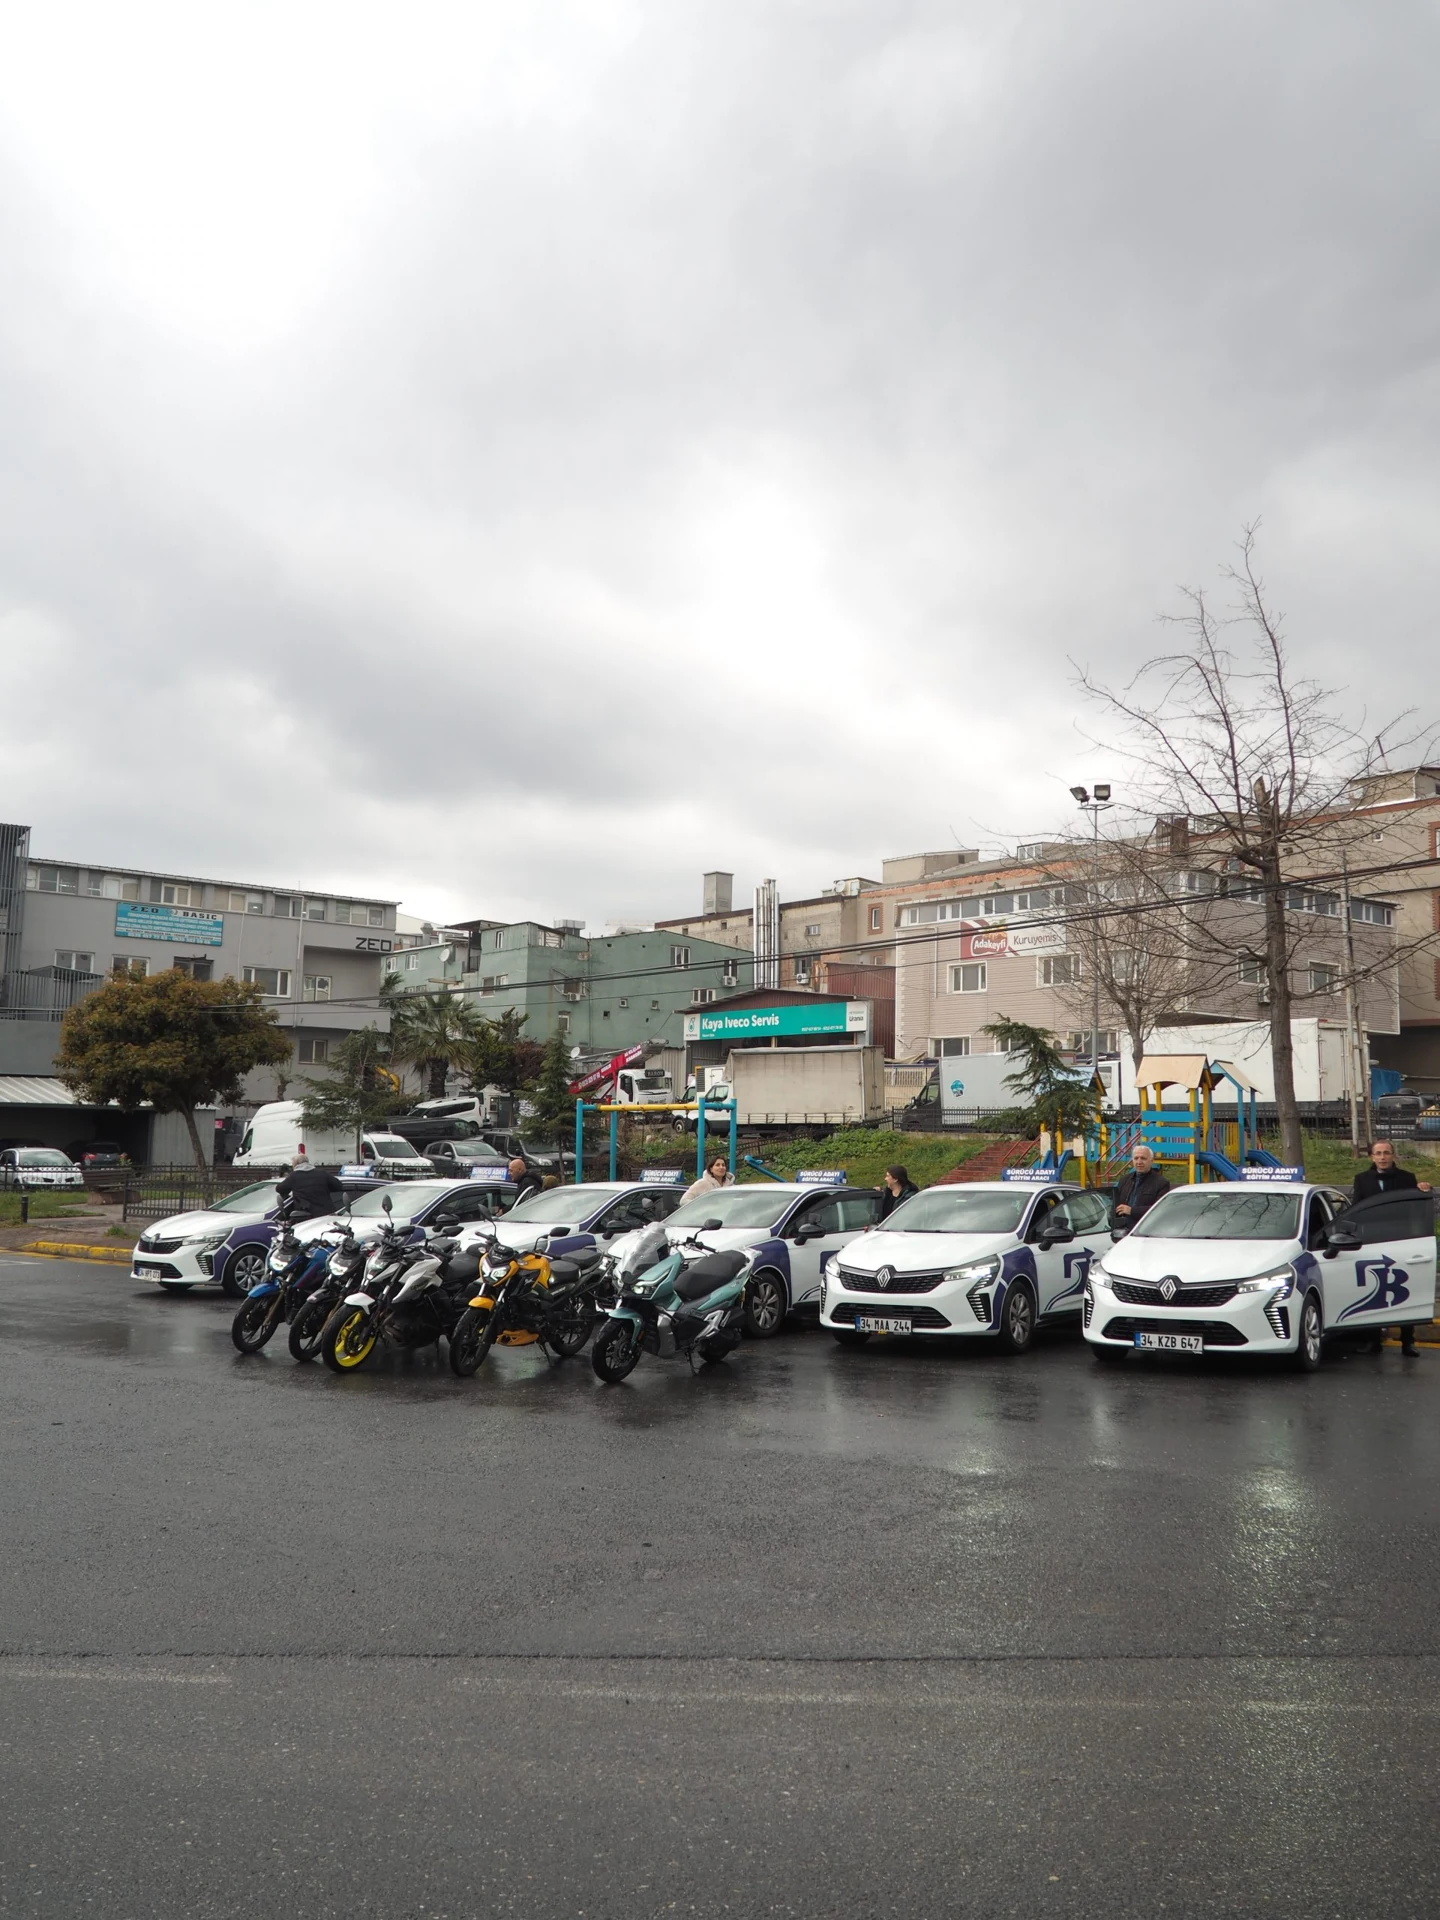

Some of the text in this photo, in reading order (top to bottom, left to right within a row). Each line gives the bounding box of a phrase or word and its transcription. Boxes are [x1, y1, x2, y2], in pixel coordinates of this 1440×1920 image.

[130, 905, 159, 914] ZEO
[182, 911, 217, 920] BASIC
[355, 936, 392, 952] ZEO
[974, 938, 1006, 952] Adakeyfi
[702, 1012, 780, 1032] Kaya Iveco Servis
[1006, 1168, 1034, 1176] SÜRÜCÜ
[1241, 1166, 1274, 1174] SÜRÜCÜ
[860, 1318, 910, 1332] 34 MAA 244
[1141, 1334, 1200, 1350] 34 KZB 647
